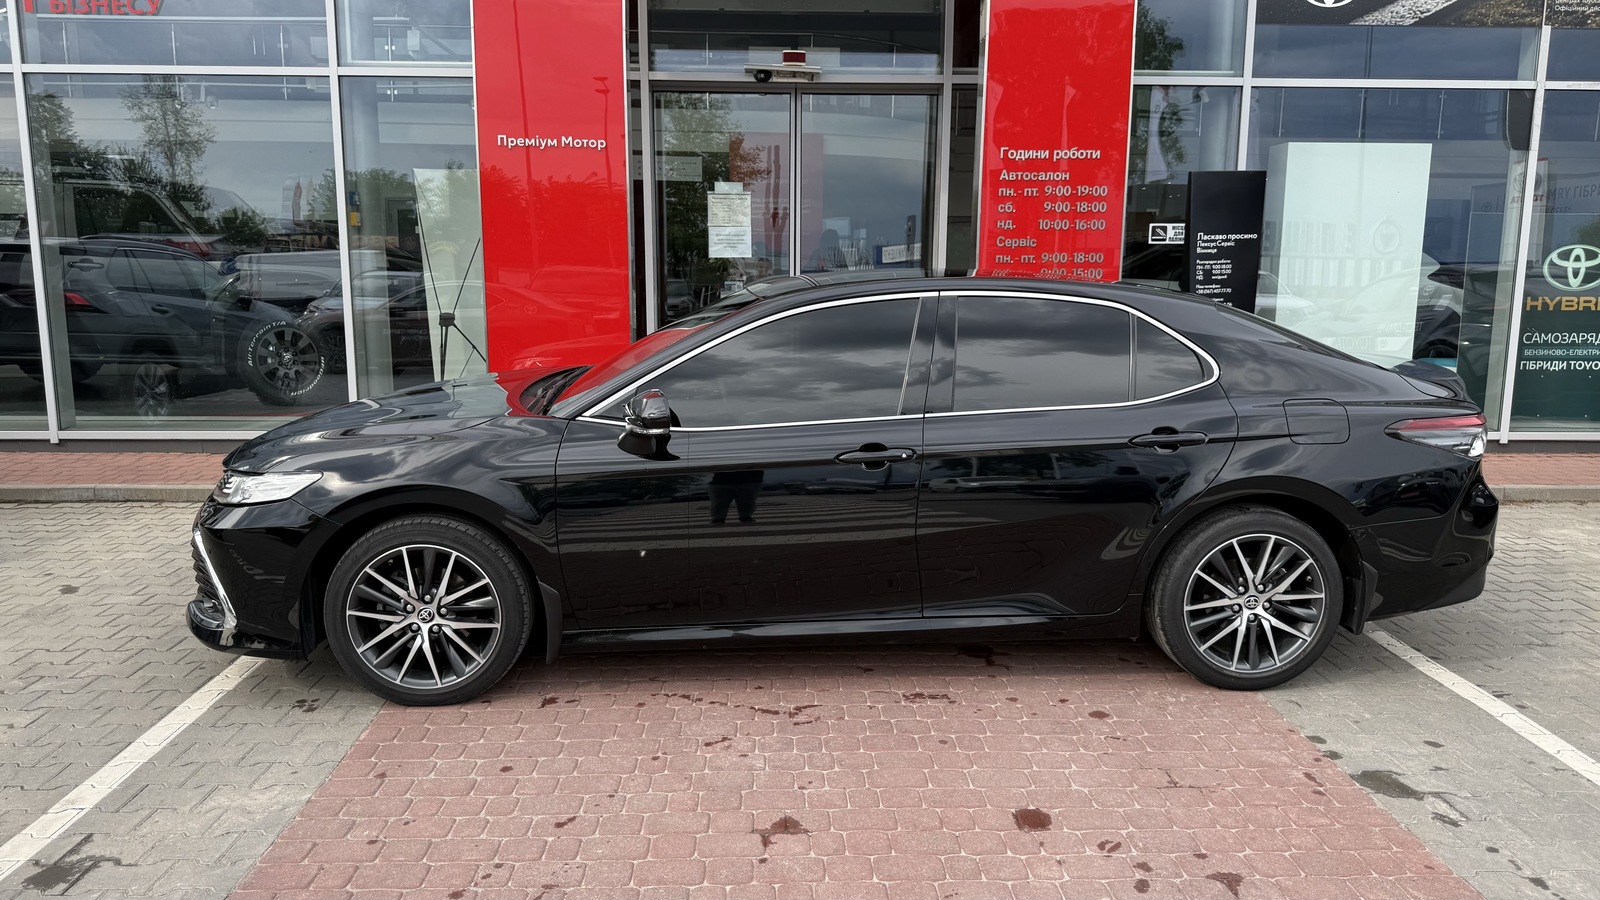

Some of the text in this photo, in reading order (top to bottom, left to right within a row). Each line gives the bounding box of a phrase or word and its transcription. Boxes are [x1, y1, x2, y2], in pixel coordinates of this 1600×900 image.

[497, 134, 606, 150] Преміум Мотор
[1000, 147, 1101, 162] Години роботи
[999, 169, 1070, 181] Автосалон
[1044, 185, 1108, 197] 9:00-19:00
[998, 201, 1107, 213] сб. 9:00-18:00
[997, 219, 1106, 231] нд. 10:00-16:00
[996, 235, 1037, 249] Сервіс
[1197, 232, 1258, 241] Ласкаво просимо
[1041, 252, 1104, 264] 9:00-18:00
[1520, 360, 1600, 372] ГІБРИДИ TOYO
